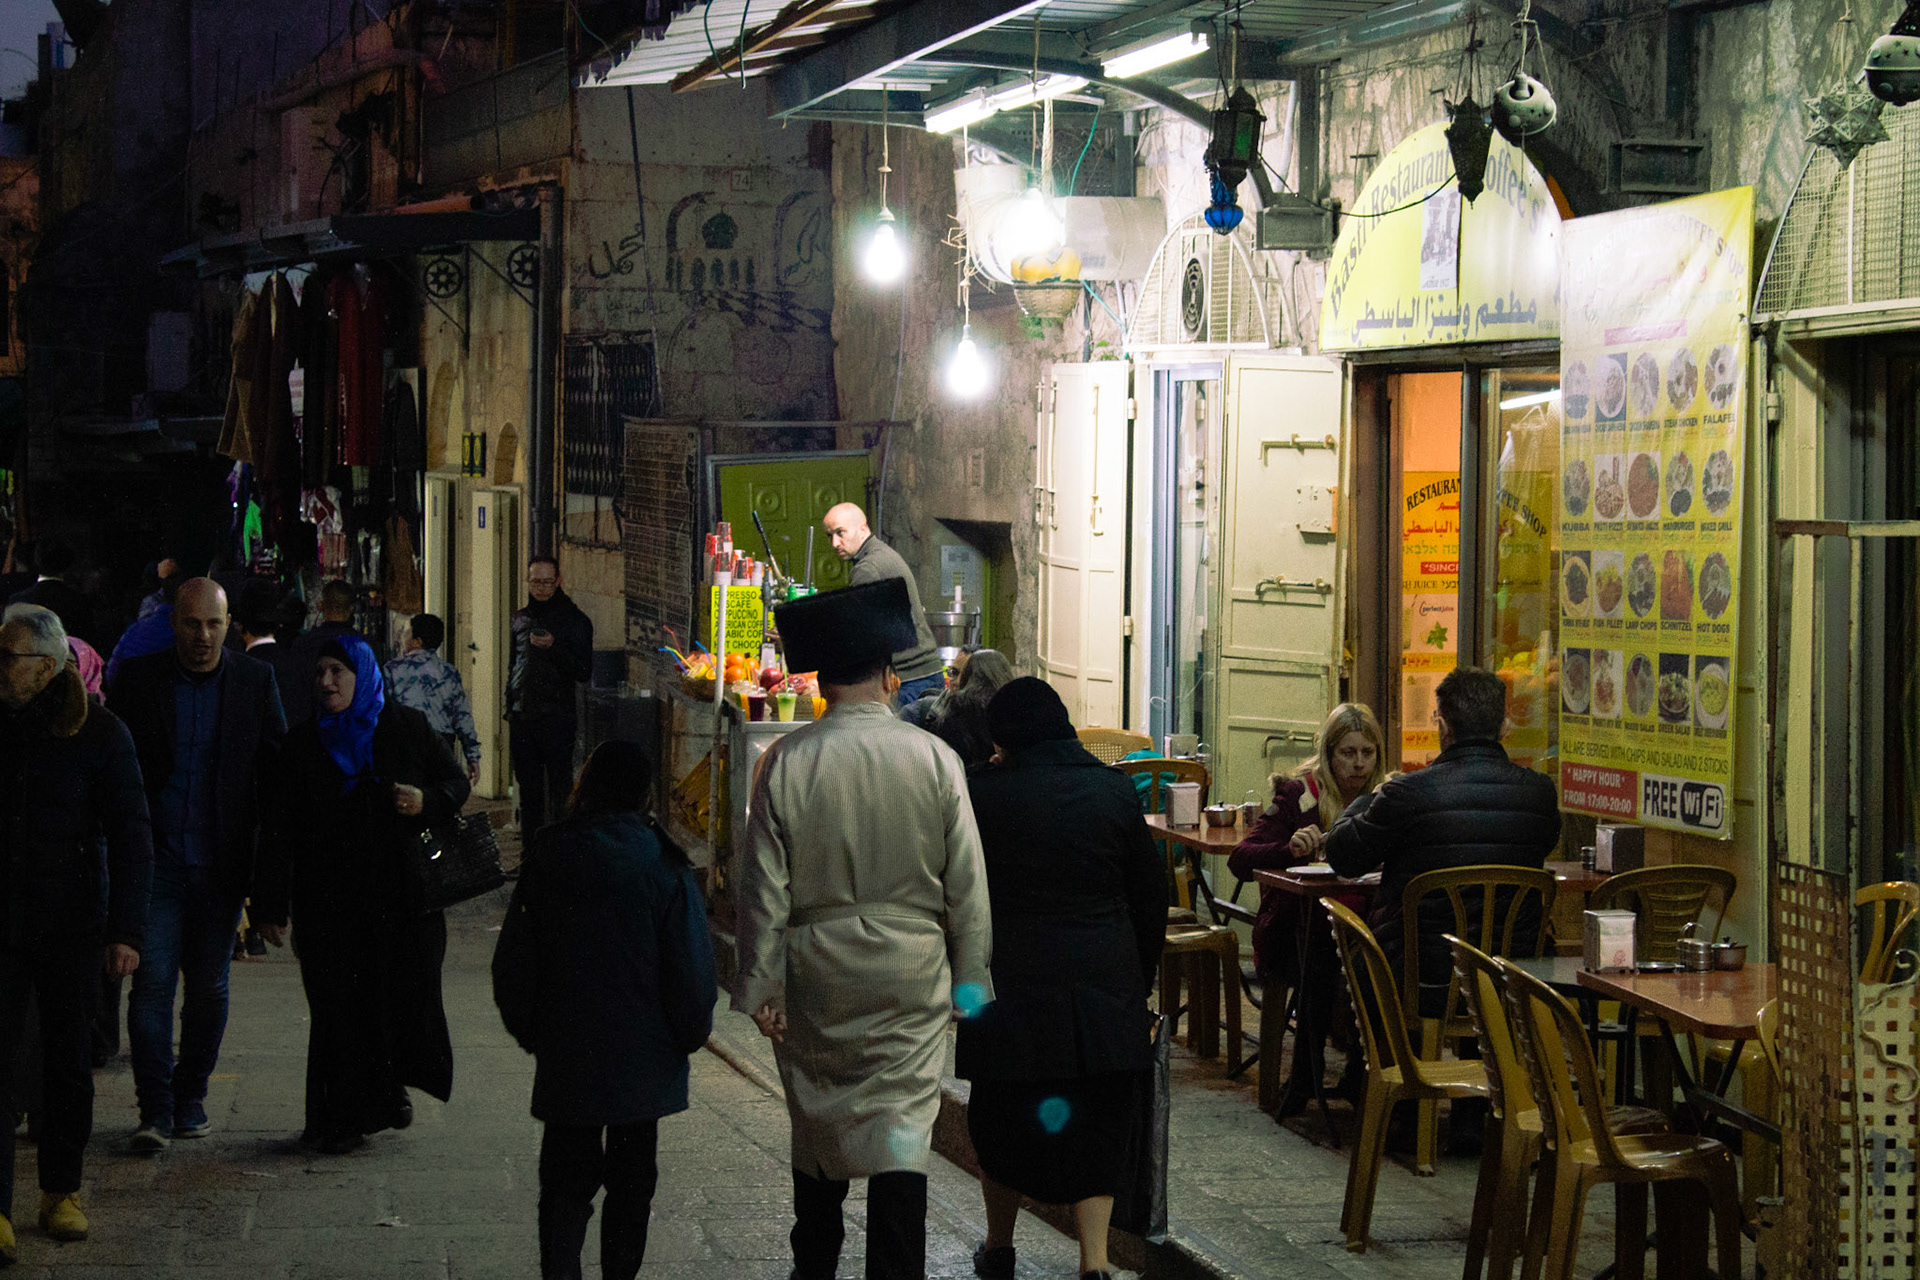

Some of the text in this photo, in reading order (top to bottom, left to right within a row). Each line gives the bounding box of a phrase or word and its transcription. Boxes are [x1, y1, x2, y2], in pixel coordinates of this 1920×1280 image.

[1485, 148, 1528, 218] offee
[1351, 294, 1421, 347] الباسطي
[1474, 289, 1537, 337] مطعم
[1703, 413, 1736, 425] FALAFEL
[1406, 478, 1460, 511] RESTAURA
[1522, 504, 1547, 537] SHOP
[1562, 522, 1589, 531] KUBBA
[1414, 580, 1438, 589] JUICE
[714, 591, 757, 599] EPRESSO
[714, 600, 751, 608] NSCAFE
[1660, 621, 1692, 632] SCHNITZEL
[1697, 623, 1731, 634] HOT DOGS
[1562, 741, 1572, 754] ALL
[1574, 742, 1585, 755] ARE
[1586, 743, 1610, 758] SERVED
[1610, 745, 1627, 760] WITH
[1627, 748, 1646, 764] CHIPS
[1647, 751, 1660, 766] AND
[1661, 753, 1682, 769] SALAD
[1683, 755, 1698, 771] AND
[1704, 758, 1729, 775] STICKS
[1572, 768, 1622, 788] HAPPY HOUR
[1564, 789, 1585, 805] FROM
[1643, 779, 1677, 818] FREE
